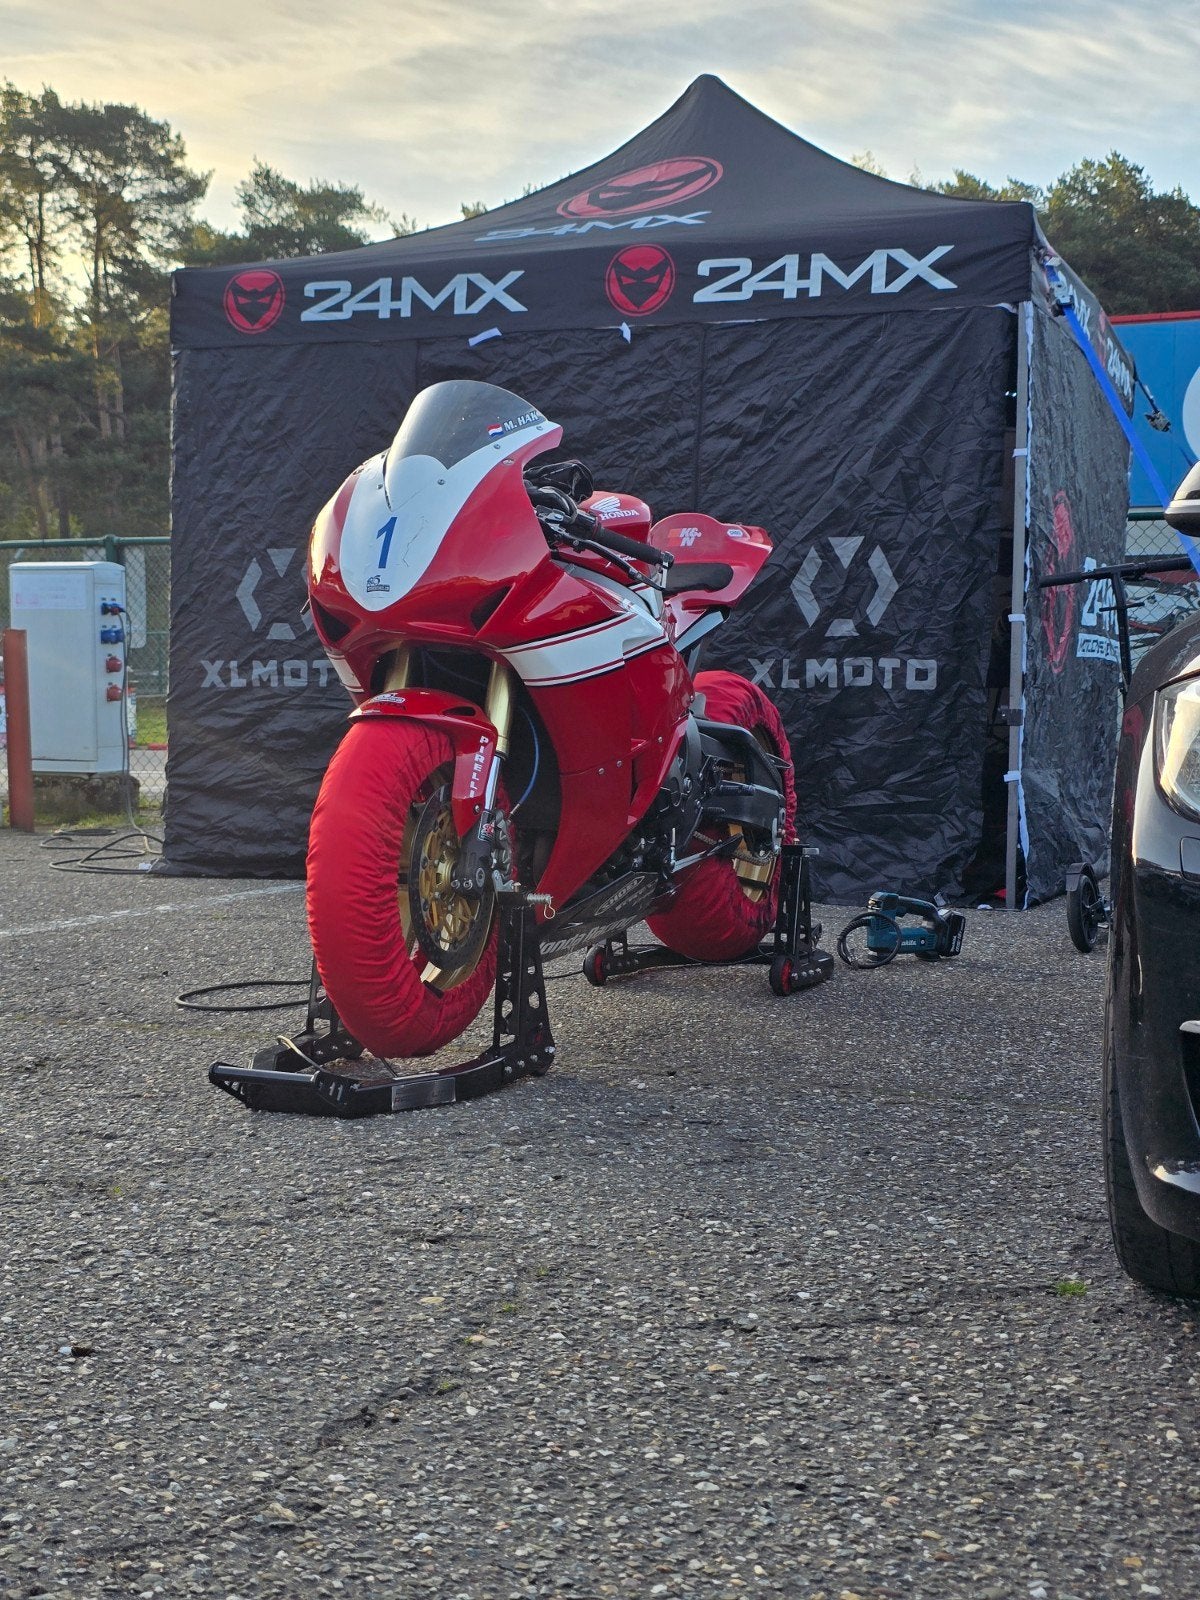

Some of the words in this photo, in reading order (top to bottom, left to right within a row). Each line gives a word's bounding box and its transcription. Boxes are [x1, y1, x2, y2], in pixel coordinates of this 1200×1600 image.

[475, 211, 712, 241] 24MX
[692, 245, 958, 303] 24MX
[300, 270, 528, 322] 24MX
[600, 509, 640, 521] HONDA
[376, 516, 398, 569] 1
[200, 659, 336, 688] XLMOT
[748, 656, 938, 690] XLMOTO
[469, 735, 489, 798] PIRELLI
[901, 938, 917, 946] akita
